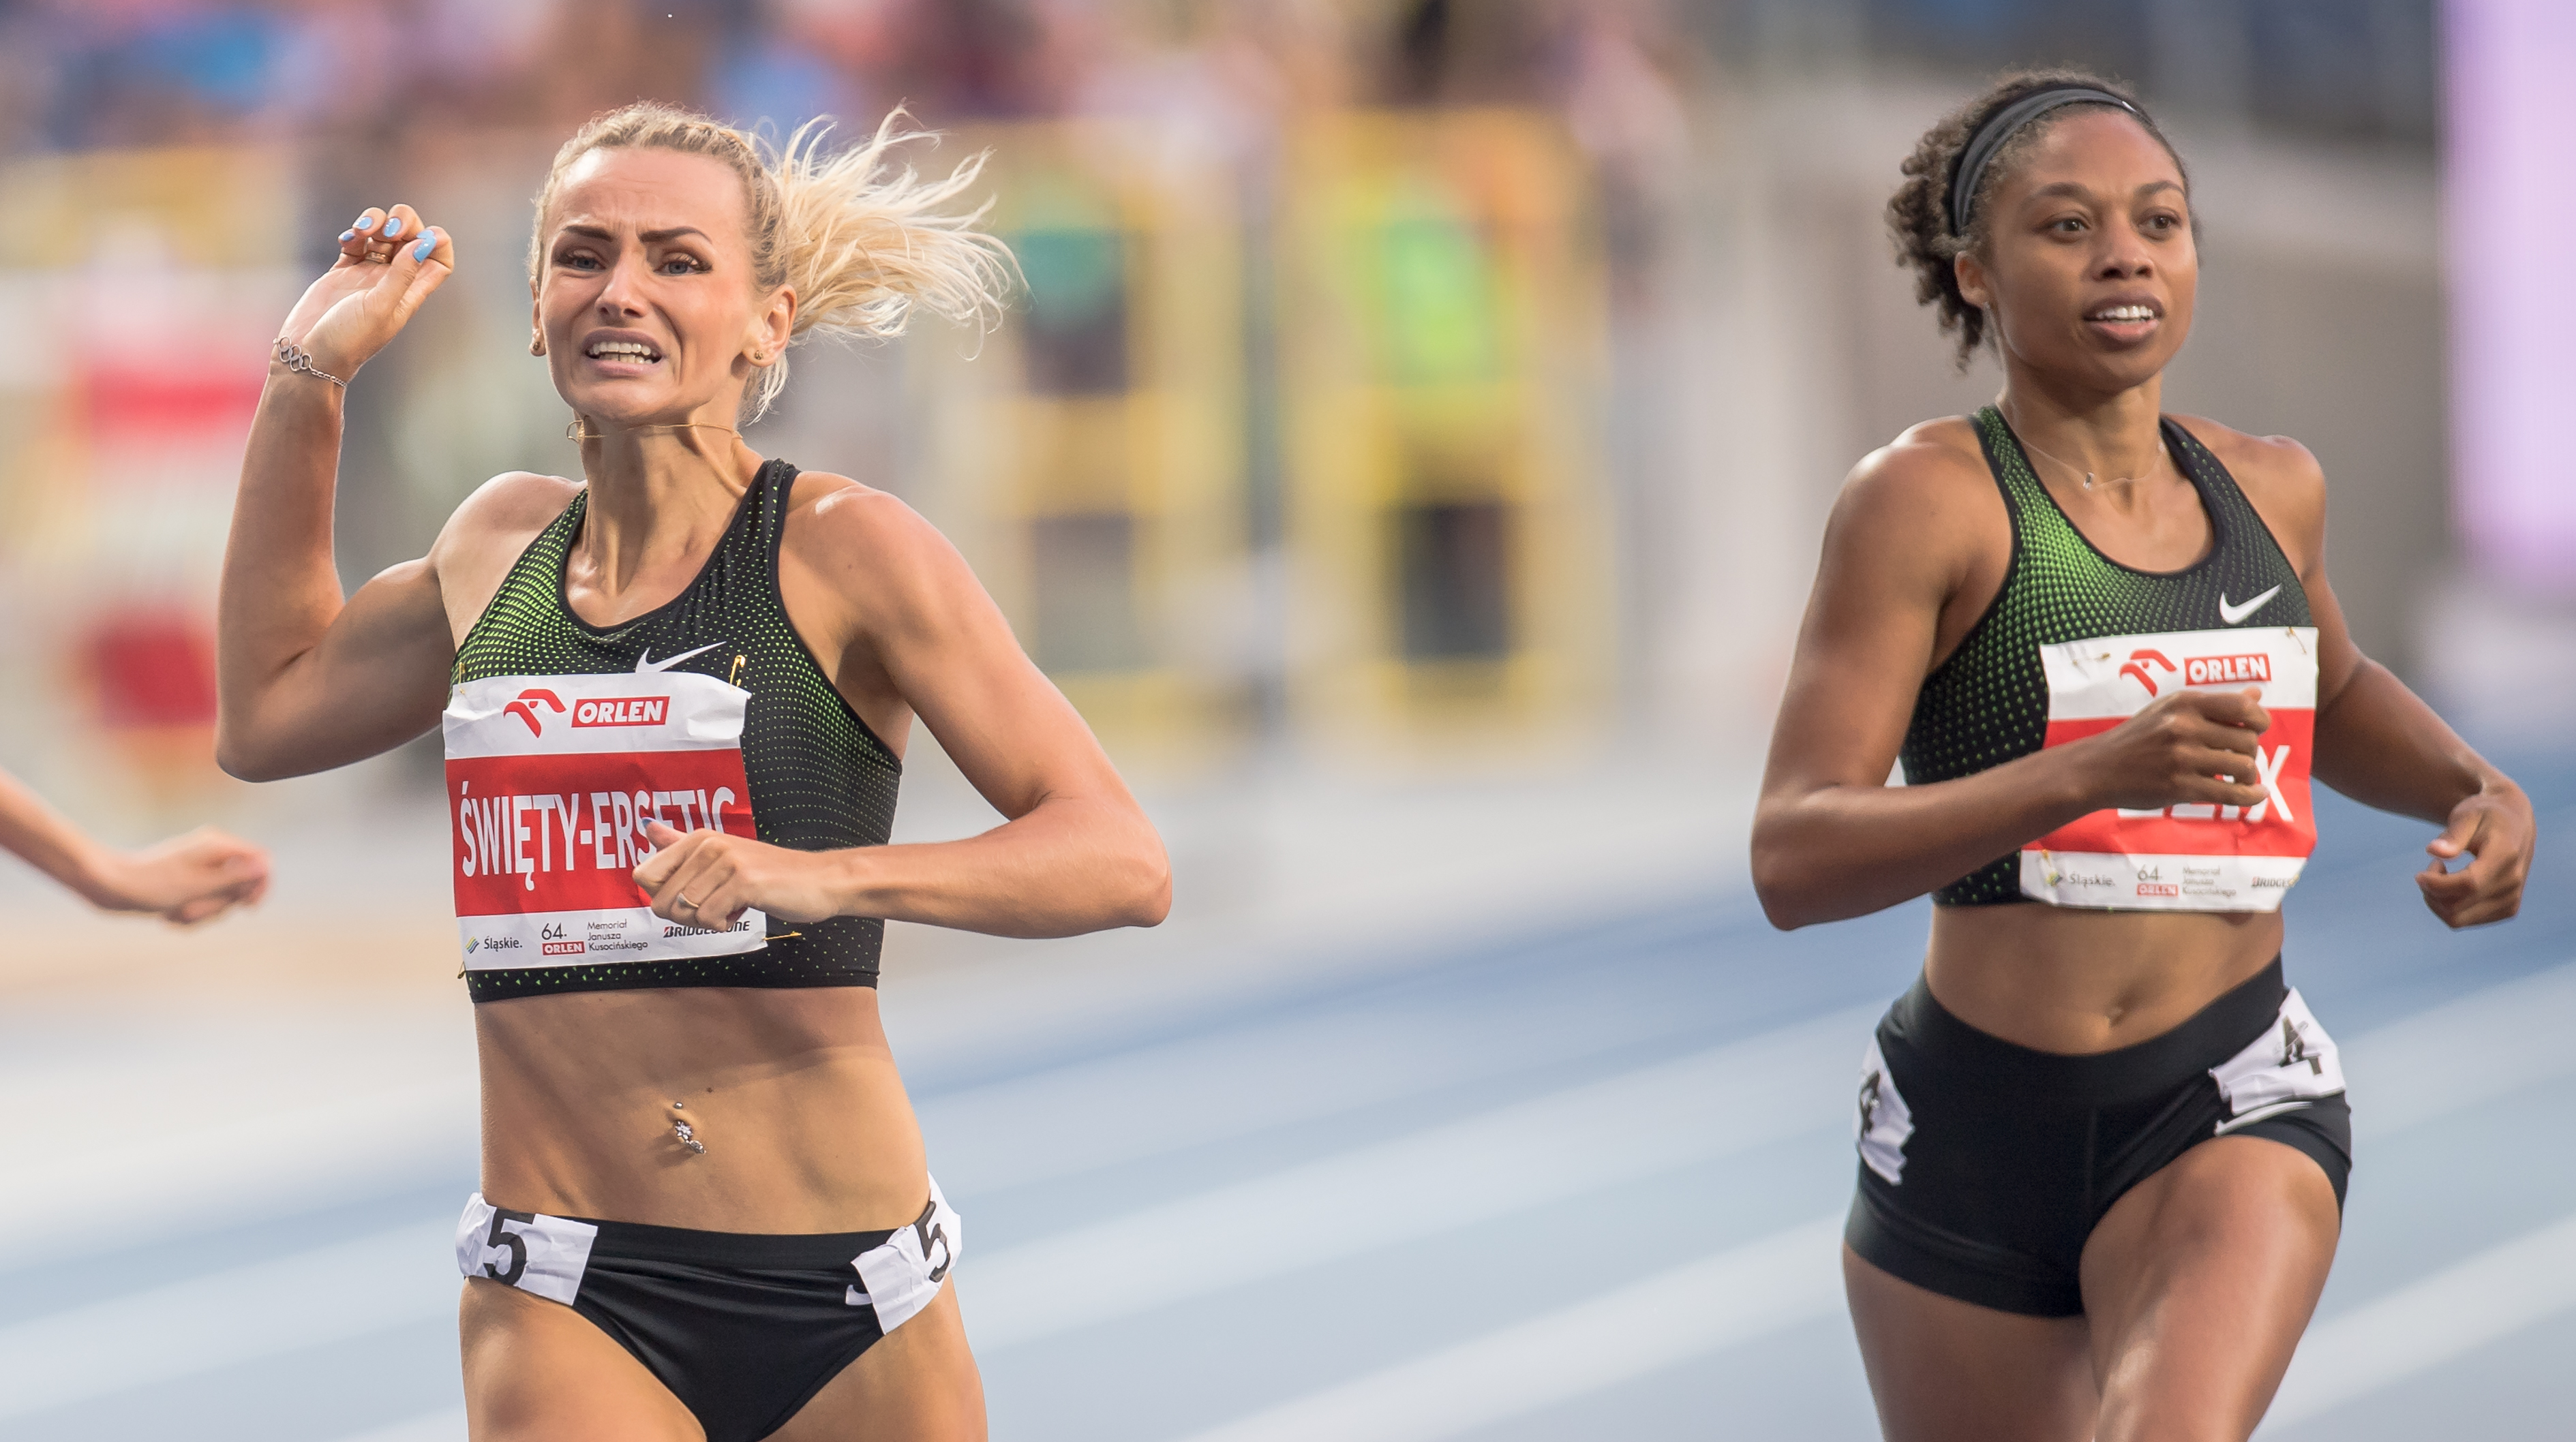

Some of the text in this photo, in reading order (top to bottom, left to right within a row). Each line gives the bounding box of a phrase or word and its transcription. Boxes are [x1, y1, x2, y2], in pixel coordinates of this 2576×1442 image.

[2189, 656, 2267, 682] ORLEN
[577, 700, 664, 724] ORLEN
[541, 922, 567, 940] 64.
[588, 932, 622, 941] Janusza
[484, 935, 523, 953] Śląskie.
[545, 943, 582, 954] ORLEN
[588, 937, 648, 951] Kusocińskiego
[483, 1206, 536, 1286] 5
[913, 1200, 951, 1283] 5
